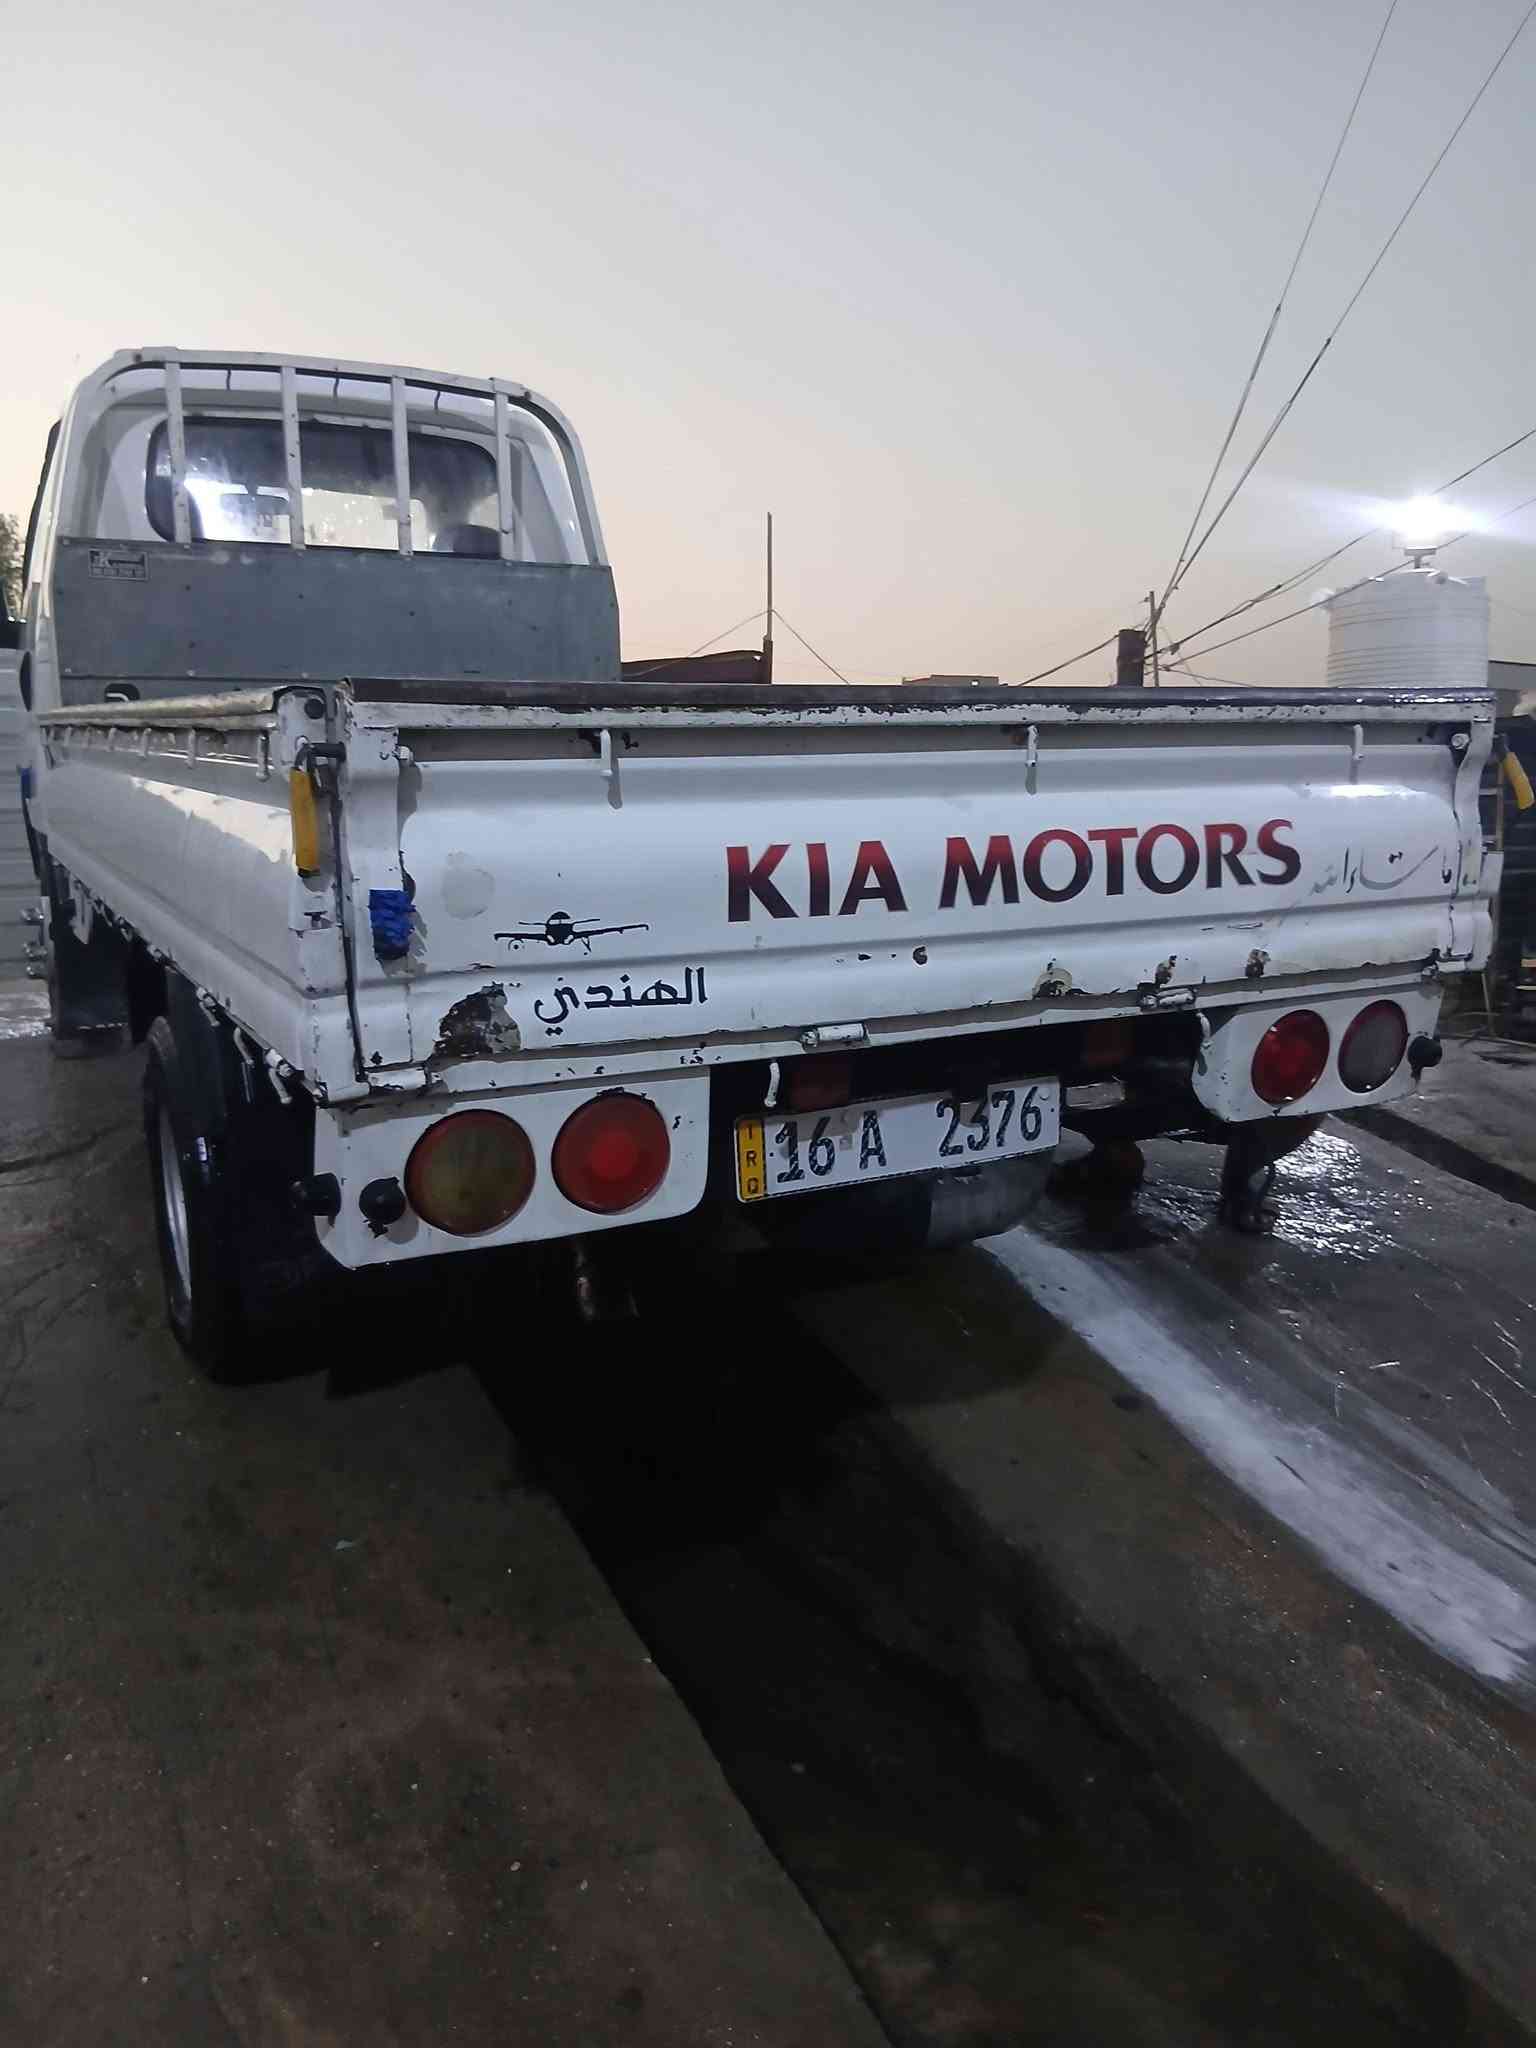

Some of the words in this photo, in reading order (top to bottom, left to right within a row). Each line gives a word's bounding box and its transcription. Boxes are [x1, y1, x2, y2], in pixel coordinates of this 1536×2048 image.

[725, 839, 908, 922] KIA
[938, 818, 1303, 910] MOTORS
[533, 966, 708, 1037] الهندي
[775, 1116, 836, 1184] 16
[859, 1109, 888, 1169] A
[936, 1085, 1043, 1158] 2376
